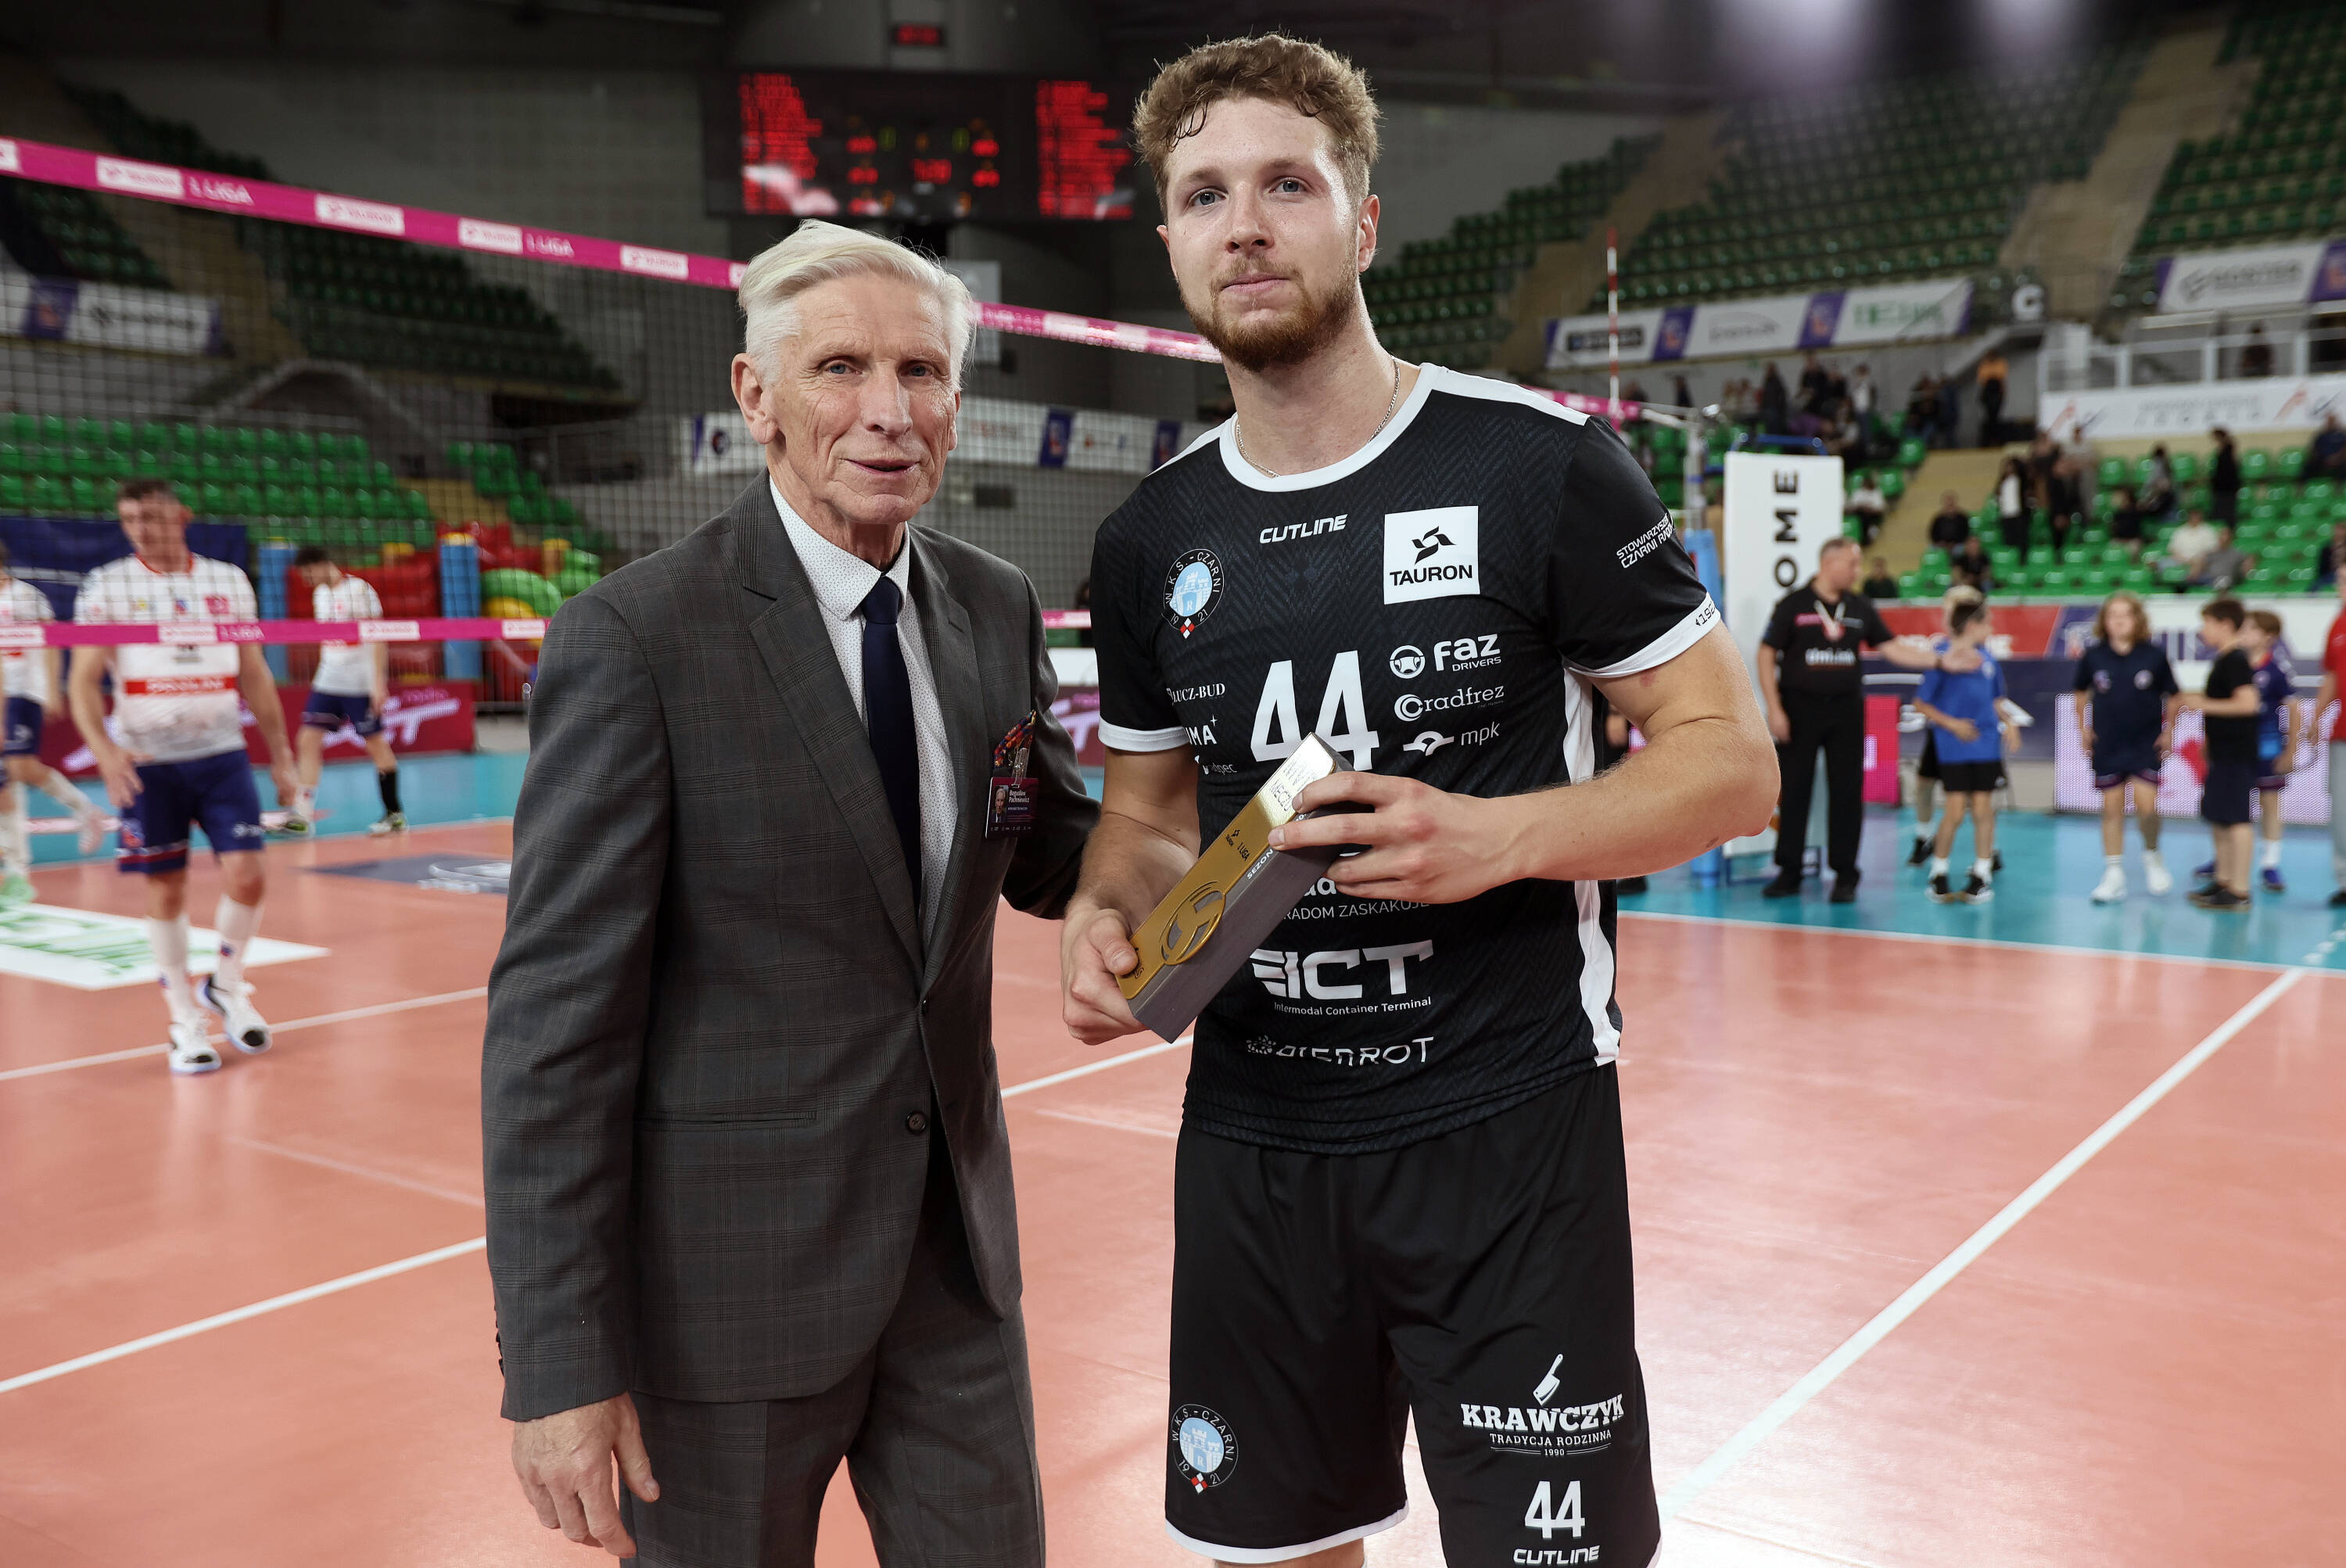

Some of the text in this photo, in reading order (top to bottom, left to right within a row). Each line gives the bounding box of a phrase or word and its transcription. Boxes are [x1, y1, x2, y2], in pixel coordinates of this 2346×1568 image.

[1259, 514, 1348, 544] CUTLINE
[1620, 540, 1659, 569] CZARNI
[1389, 565, 1473, 587] TAURON
[1433, 633, 1501, 671] faz
[1451, 656, 1501, 672] DRIVERS
[1250, 650, 1380, 771] 44
[1461, 721, 1501, 746] mpk
[1247, 849, 1274, 880] SEZON
[1274, 996, 1432, 1016] Intermodal Container Terminal
[1460, 1393, 1624, 1432] KRAWCZYK
[1490, 1429, 1612, 1446] TRADYCJA RODZINNA
[1544, 1448, 1565, 1457] 1990
[1524, 1480, 1586, 1539] 44
[1513, 1545, 1601, 1565] CUTLINE
